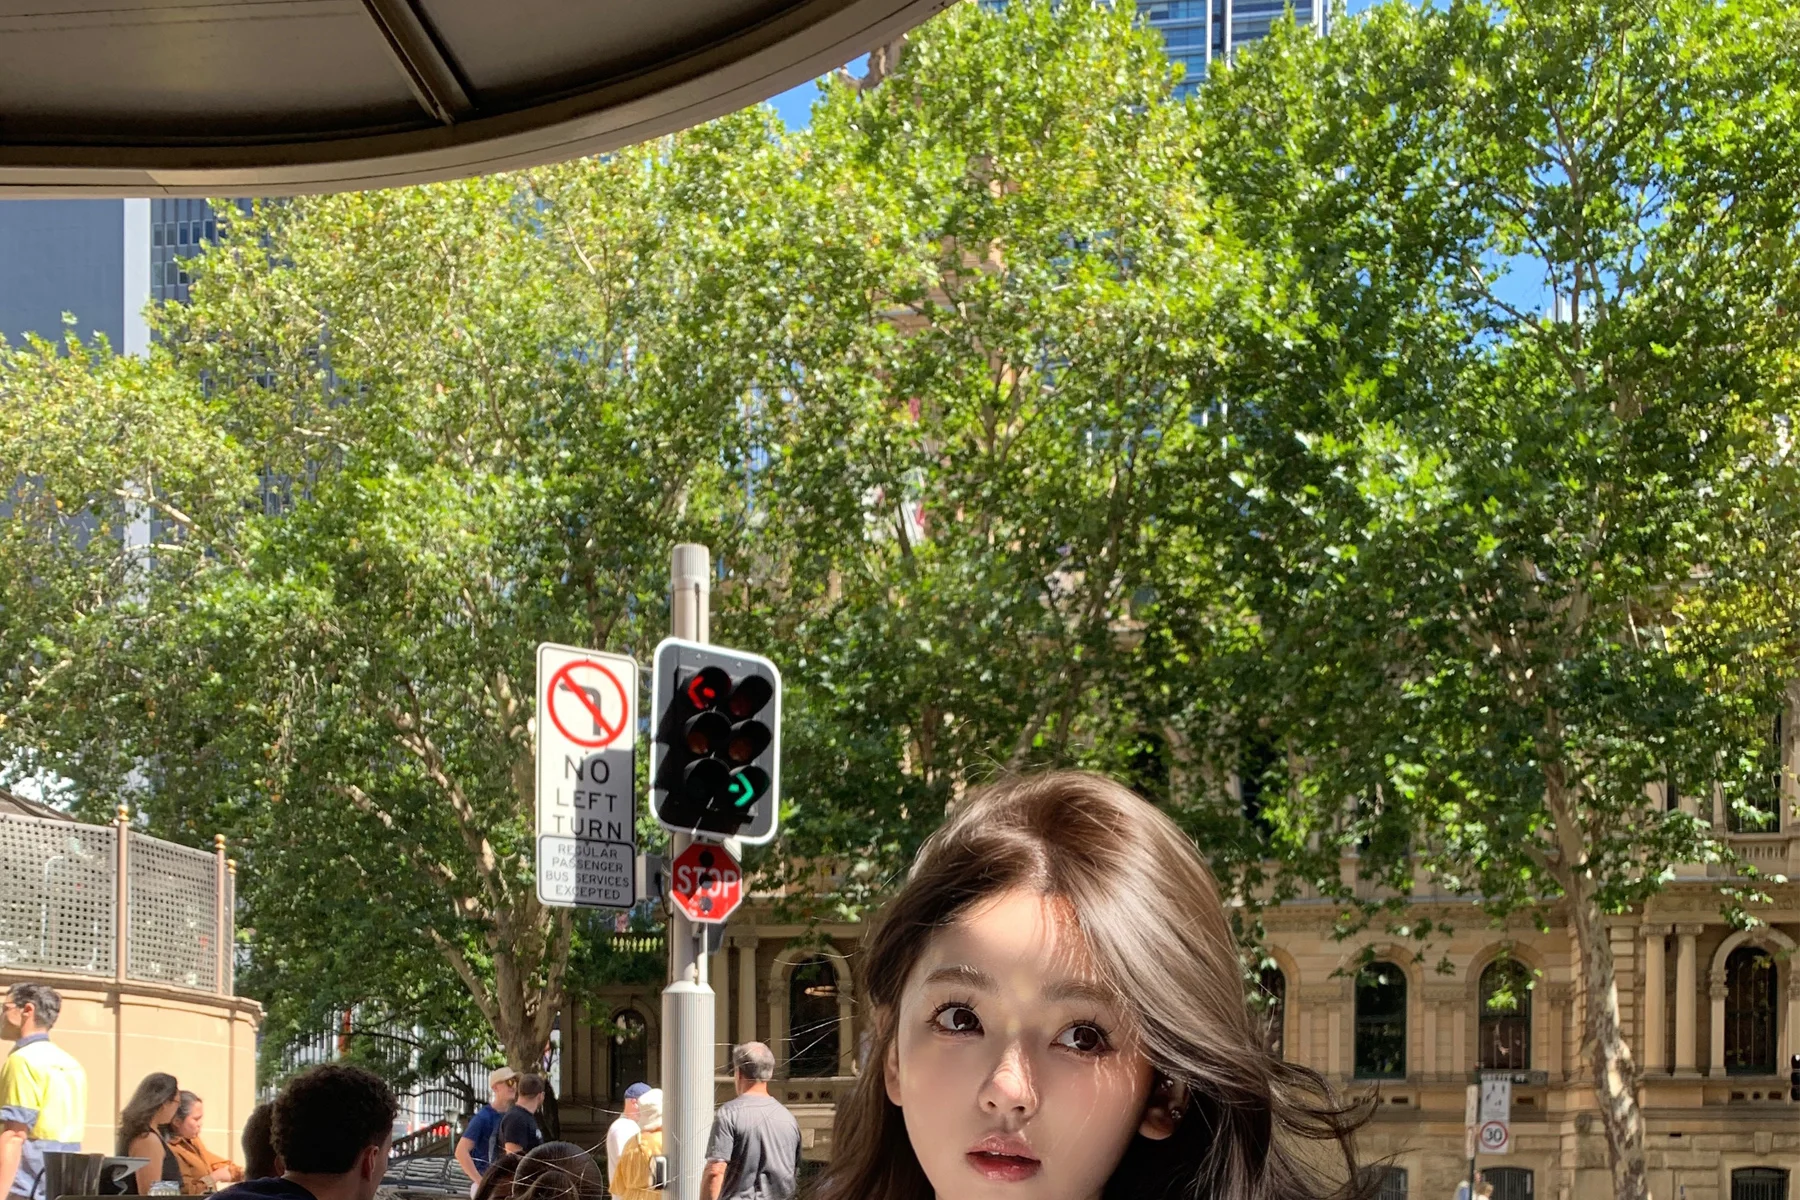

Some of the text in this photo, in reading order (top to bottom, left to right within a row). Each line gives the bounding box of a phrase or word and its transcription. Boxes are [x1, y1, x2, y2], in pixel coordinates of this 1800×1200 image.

[565, 755, 609, 784] NO
[557, 788, 617, 812] LEFT
[552, 814, 621, 840] TURN
[558, 844, 617, 858] REGULAR
[552, 857, 623, 872] PASSENGER
[545, 870, 629, 888] BUS SERVICES
[677, 865, 738, 898] STOP
[555, 885, 620, 900] EXCEPTED
[1485, 1128, 1503, 1143] 30
